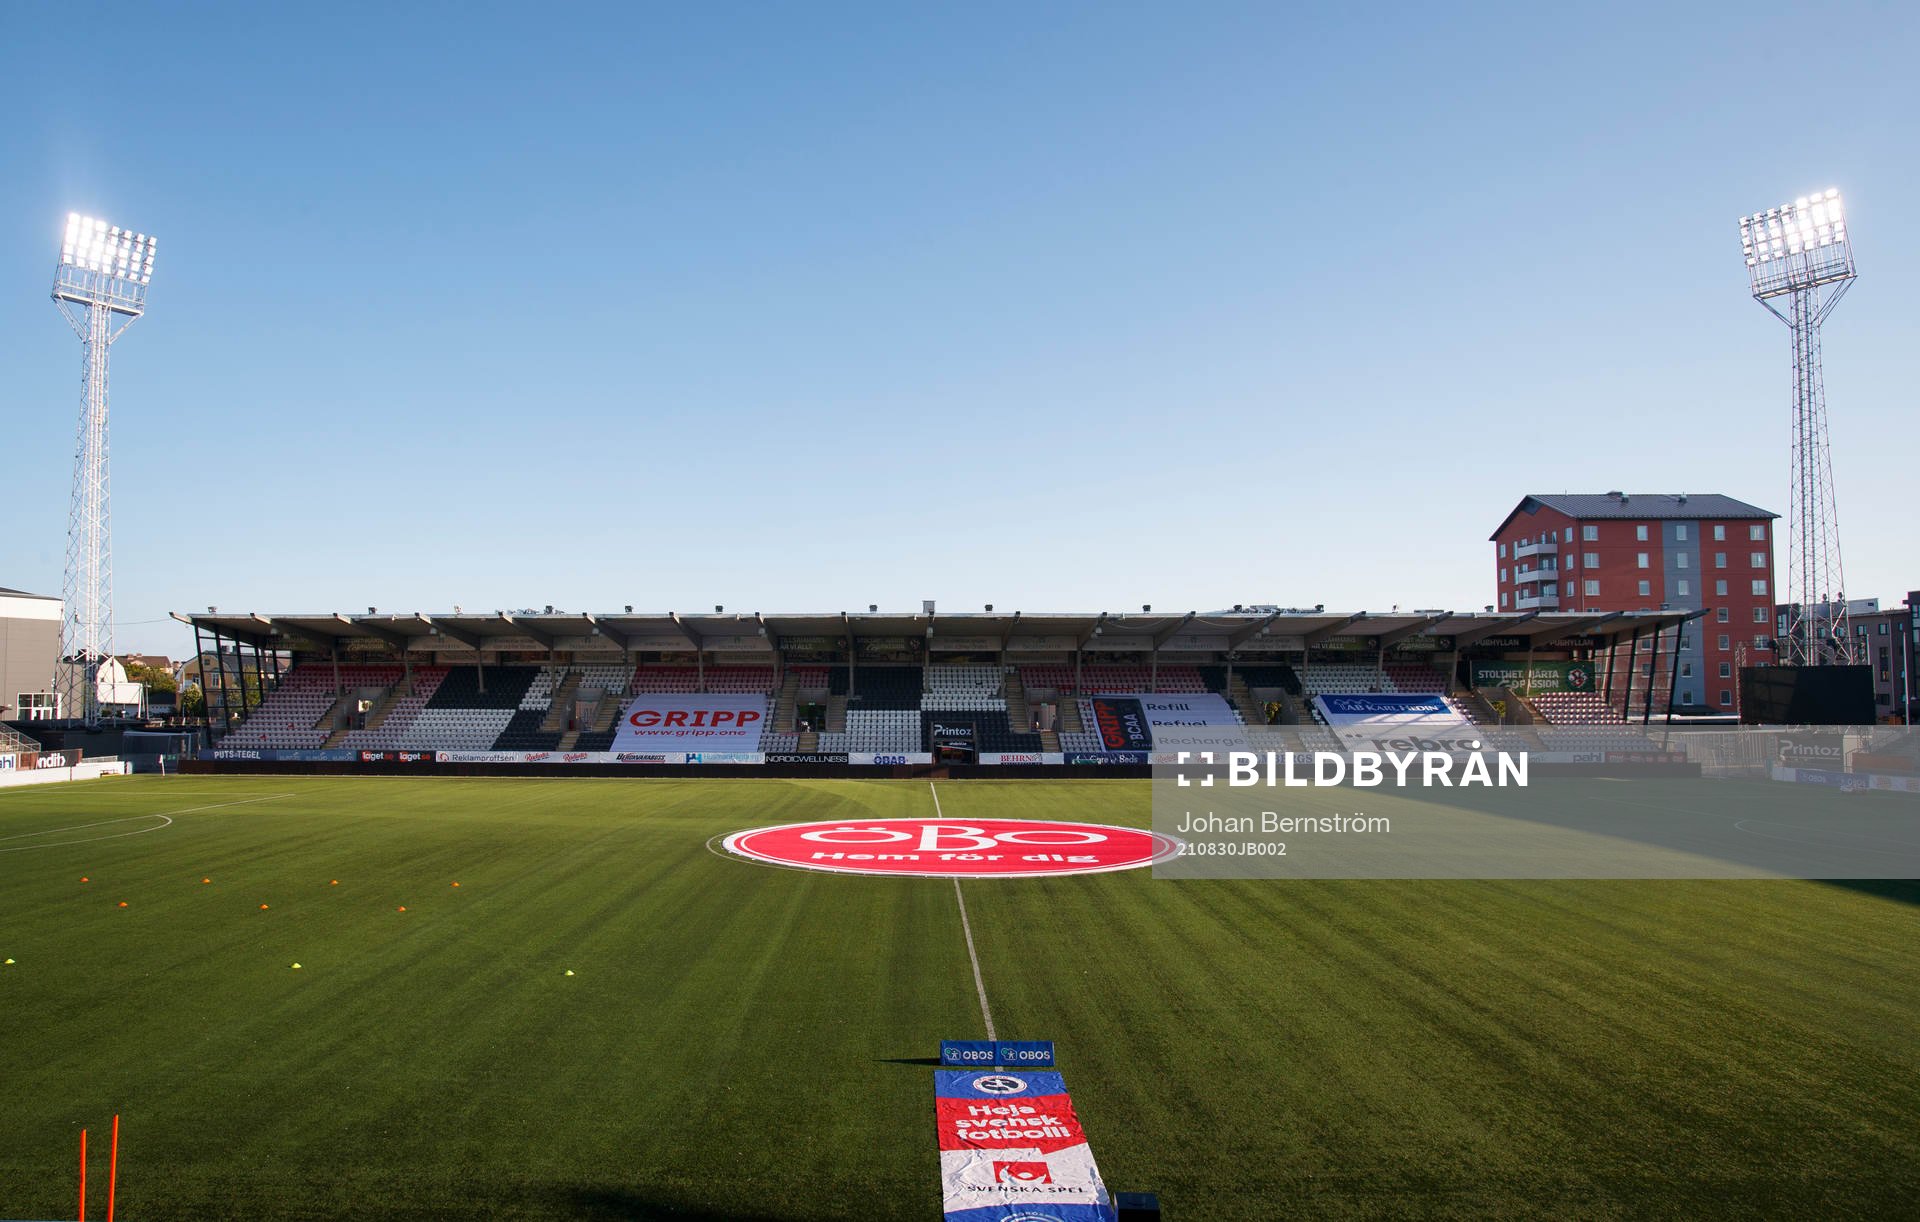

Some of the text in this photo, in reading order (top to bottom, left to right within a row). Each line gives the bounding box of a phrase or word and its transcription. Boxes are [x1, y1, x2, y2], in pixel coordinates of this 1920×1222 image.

[1147, 703, 1190, 711] Refill
[630, 710, 760, 728] GRIPP
[934, 724, 972, 736] Printoz
[1780, 740, 1841, 756] Printoz
[1000, 754, 1032, 762] BEHRN
[800, 825, 1107, 851] ÖBO
[811, 852, 1099, 863] Hem för dig
[962, 1051, 993, 1060] OBOS
[1019, 1051, 1050, 1060] OBOS
[968, 1106, 1036, 1116] Heja
[956, 1115, 1062, 1128] svensk
